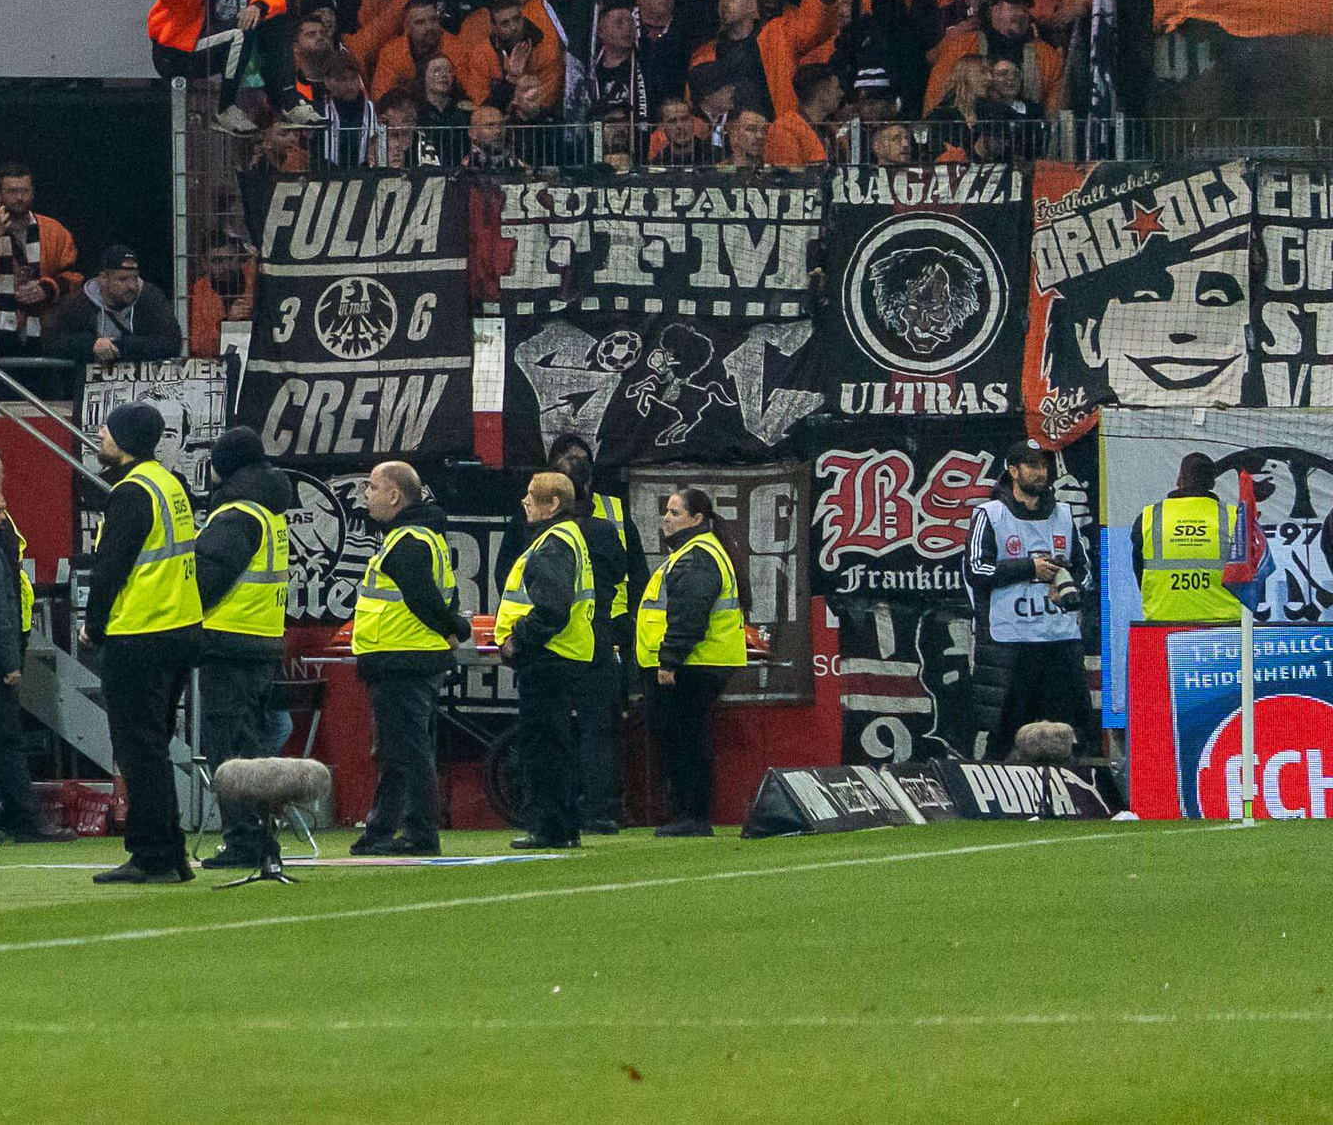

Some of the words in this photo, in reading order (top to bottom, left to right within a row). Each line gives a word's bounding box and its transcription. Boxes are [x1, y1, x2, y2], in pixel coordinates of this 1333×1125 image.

[832, 161, 1023, 205] RAGAZZI
[500, 182, 823, 221] KUMPANE
[1035, 185, 1108, 221] Football
[261, 177, 446, 260] FULDA
[272, 297, 301, 343] 3
[339, 301, 371, 316] ULTRAS
[140, 358, 228, 382] IMMER
[839, 382, 1008, 415] ULTRAS
[263, 374, 447, 457] CREW
[1173, 525, 1207, 537] SDS
[836, 564, 962, 593] Frankfu
[1170, 572, 1211, 591] 2505
[1014, 596, 1071, 617] CLU
